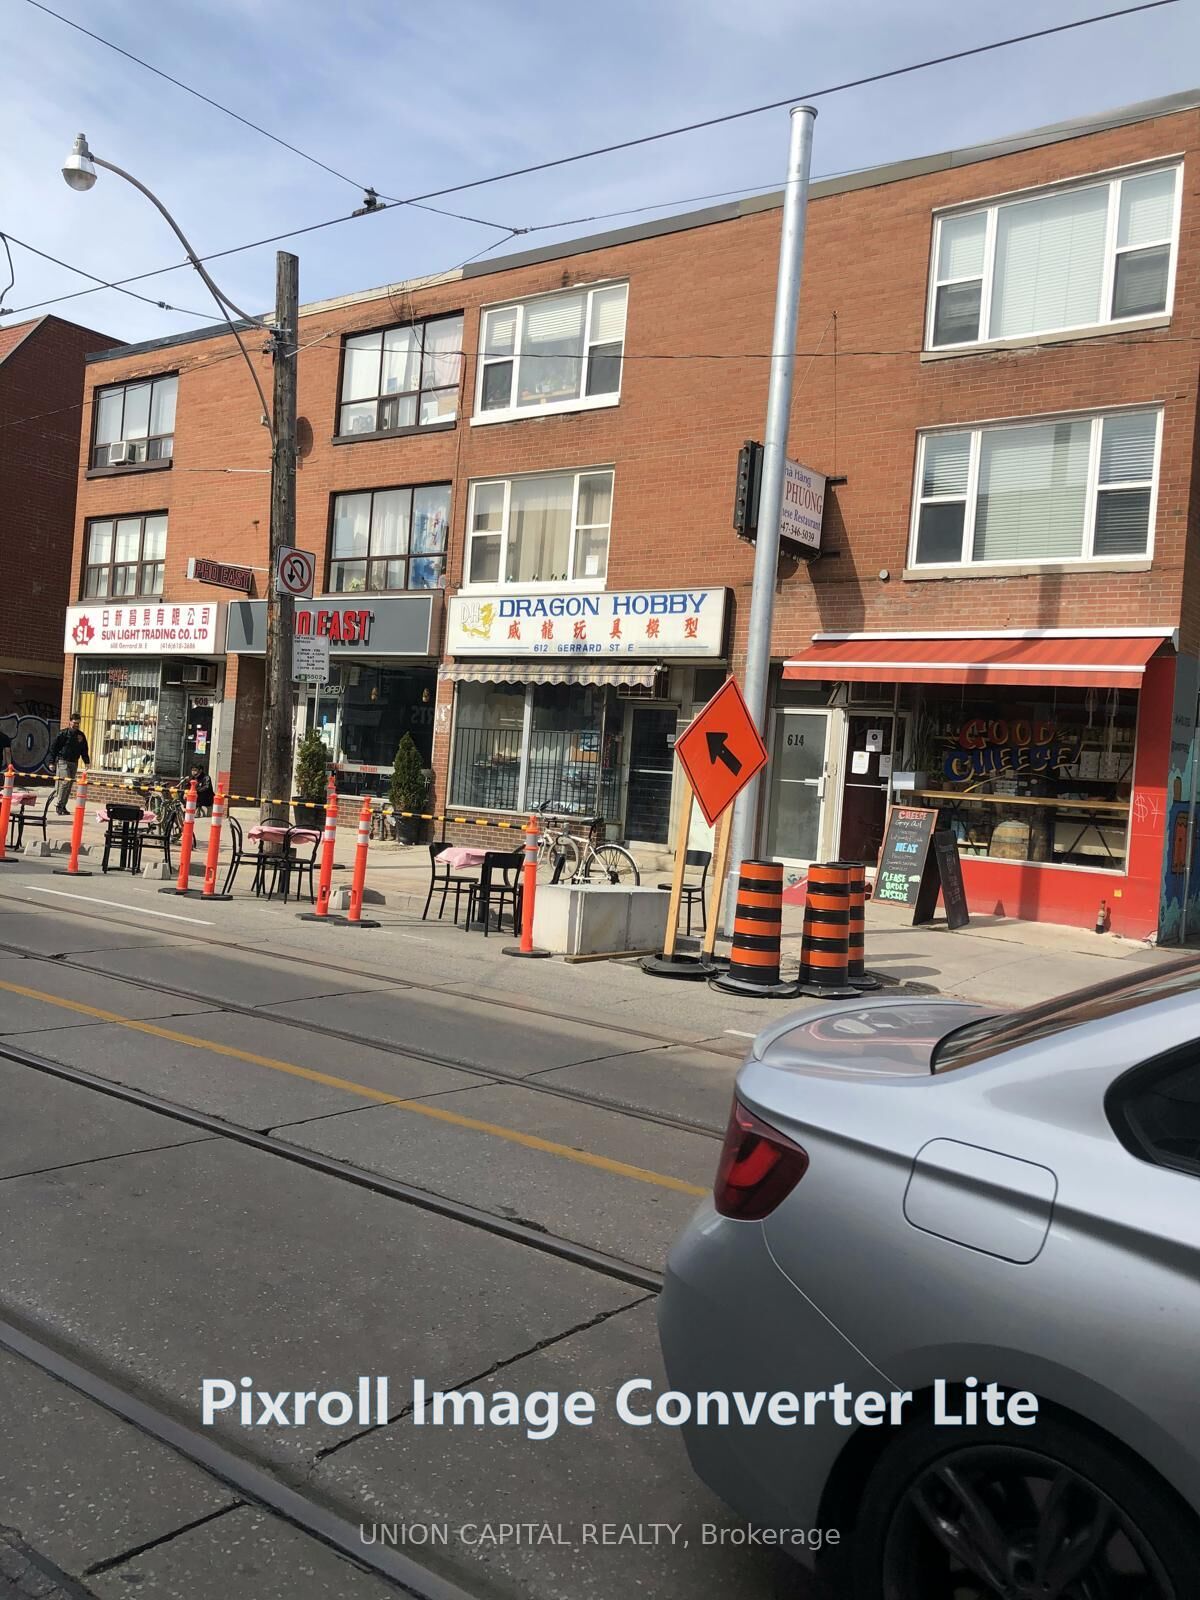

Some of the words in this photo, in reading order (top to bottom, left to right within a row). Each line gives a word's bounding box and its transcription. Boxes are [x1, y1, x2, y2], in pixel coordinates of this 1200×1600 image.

[786, 481, 822, 514] PHUONG
[794, 510, 820, 530] Restaurant
[780, 520, 815, 542] 47-346-5039
[195, 562, 218, 581] PHO
[220, 567, 250, 589] EAST
[499, 597, 600, 618] DRAGON
[612, 593, 708, 615] HOBBY
[316, 610, 371, 641] EAST
[508, 618, 699, 641] 威龍玩具模型
[102, 630, 115, 640] SUN
[117, 629, 140, 640] LIGHT
[141, 629, 176, 640] TRADING
[178, 629, 192, 640] CO.
[194, 628, 208, 640] LTD
[534, 644, 549, 653] 612
[557, 643, 602, 653] GERRARD
[609, 643, 621, 652] ST
[628, 643, 635, 652] E
[324, 685, 346, 695] OPEN
[960, 718, 1055, 749] GOOD
[787, 734, 805, 747] 614
[898, 811, 928, 821] CHEESE
[895, 842, 919, 853] MEAT
[882, 871, 906, 883] PLEASE
[885, 881, 909, 892] ORDER
[879, 889, 909, 901] INSIDE
